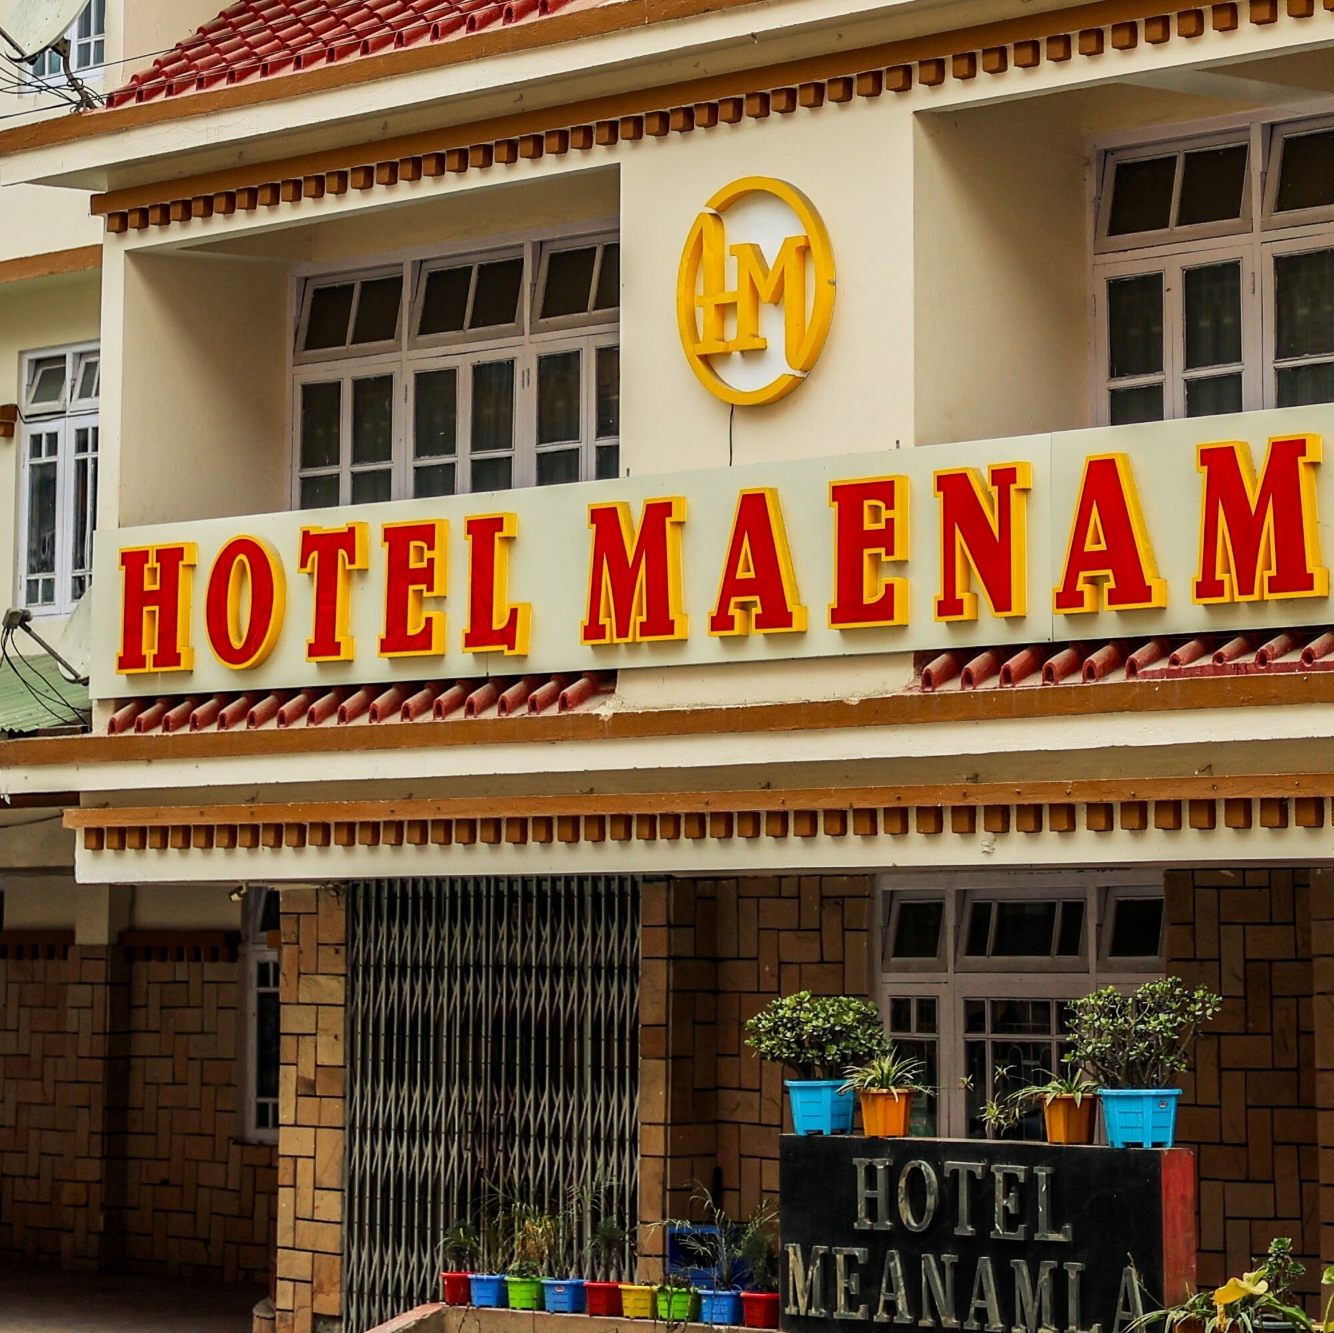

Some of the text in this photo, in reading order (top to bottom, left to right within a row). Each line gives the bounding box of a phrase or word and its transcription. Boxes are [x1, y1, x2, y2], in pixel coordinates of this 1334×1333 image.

[116, 511, 533, 675] HOTEL
[852, 1157, 1073, 1242] HOTEL
[784, 1243, 1146, 1333] MEANAMLA
